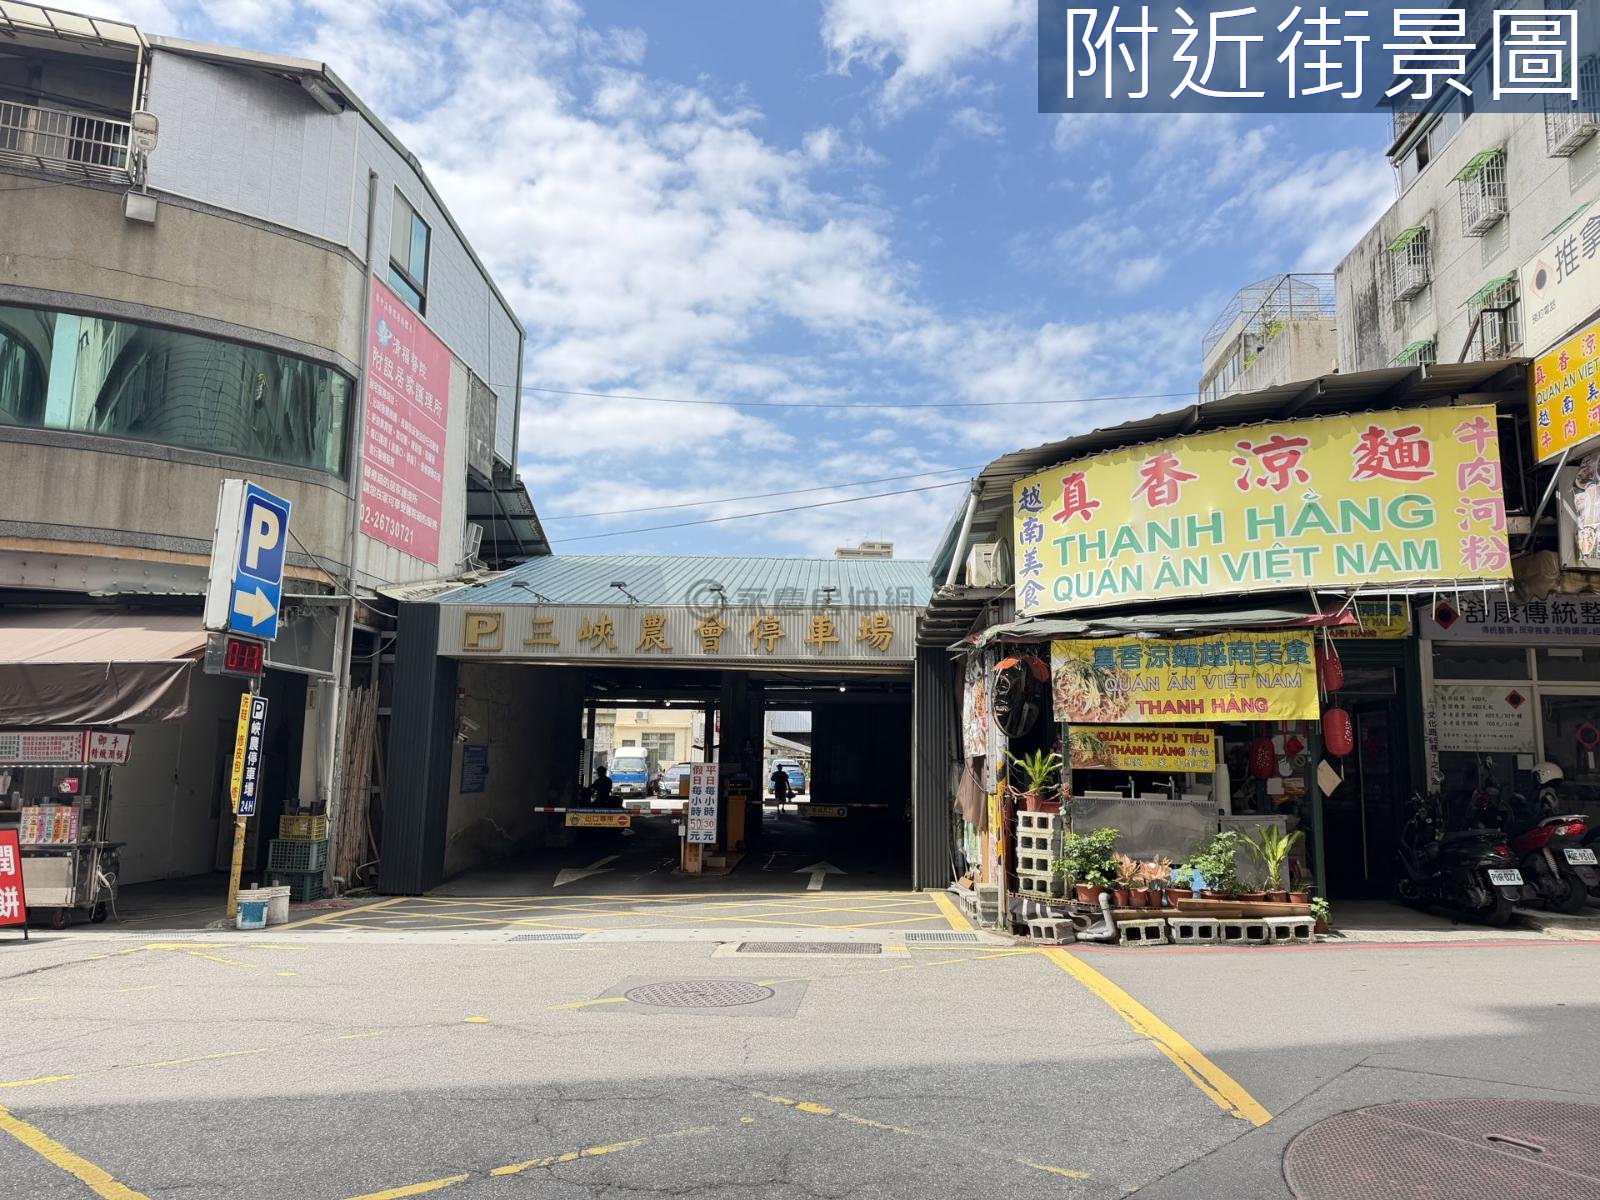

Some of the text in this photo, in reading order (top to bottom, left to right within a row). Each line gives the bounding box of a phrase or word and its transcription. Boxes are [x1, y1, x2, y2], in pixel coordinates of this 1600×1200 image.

[1052, 425, 1435, 524] 真香涼麵
[1455, 416, 1508, 571] 牛肉河粉
[246, 503, 280, 570] P
[359, 503, 414, 545] 02-26730721
[1018, 483, 1045, 609] 越南美食
[1052, 512, 1223, 567] THANH
[1053, 539, 1439, 602] QUÁN ĂN VIỆT NAM
[523, 612, 895, 653] 三峽農會停車場
[1093, 639, 1311, 671] 真香涼麵越南美食
[1136, 699, 1205, 715] THANH
[1256, 671, 1303, 689] NAM
[239, 800, 255, 813] 24H
[690, 765, 703, 842] 假日每小時50元
[703, 765, 717, 842] 平日每小時30元
